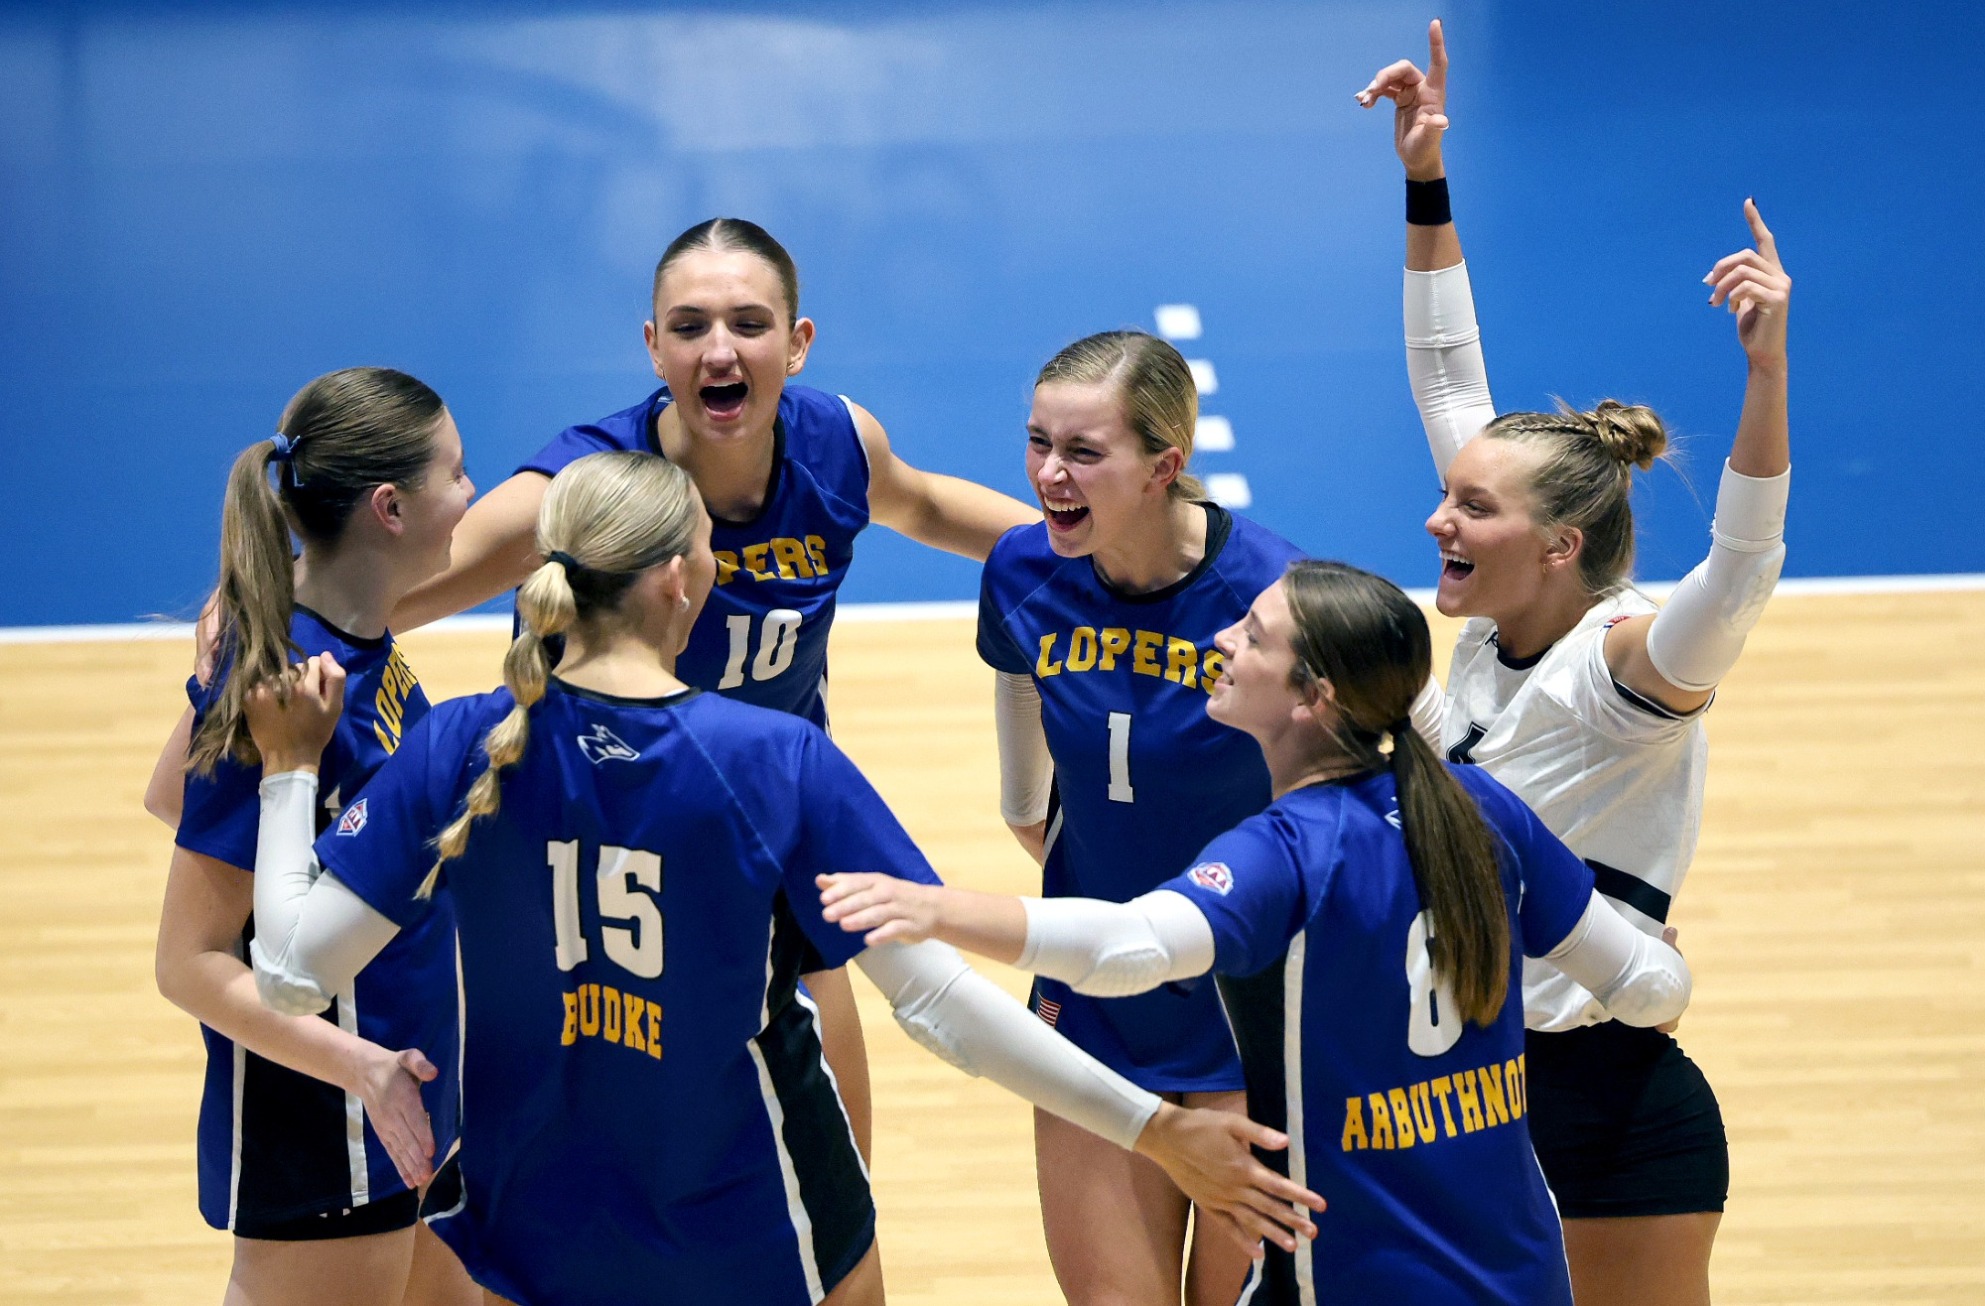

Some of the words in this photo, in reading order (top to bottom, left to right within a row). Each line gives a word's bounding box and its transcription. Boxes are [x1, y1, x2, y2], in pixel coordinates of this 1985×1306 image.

[712, 534, 829, 586] PERS
[717, 608, 803, 690] 10
[1036, 626, 1226, 696] LOPERS
[1107, 711, 1134, 803] 1
[547, 838, 664, 979] 15
[560, 983, 663, 1061] BUDKE
